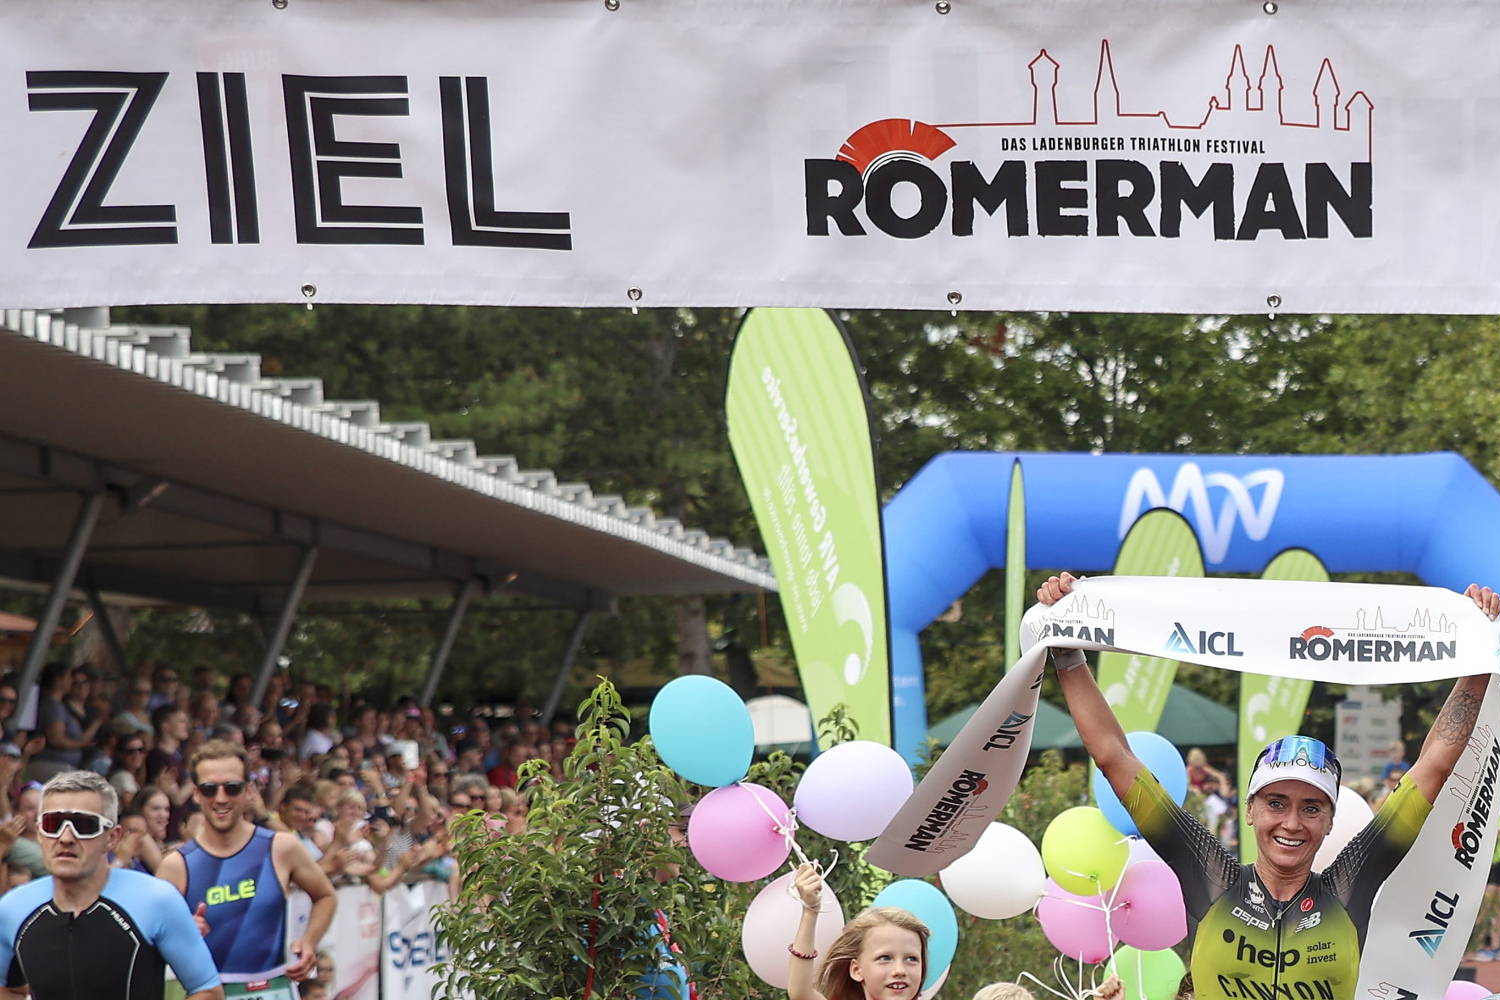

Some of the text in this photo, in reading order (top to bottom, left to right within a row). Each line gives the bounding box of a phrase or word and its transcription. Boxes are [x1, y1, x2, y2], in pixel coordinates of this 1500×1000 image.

[1001, 136, 1266, 155] DAS LADENBURGER TRIATHLON FESTIVAL
[26, 71, 573, 250] ZIEL
[1199, 630, 1244, 657] ICL
[983, 729, 1022, 752] ICL
[1424, 890, 1460, 929] ICL
[1236, 935, 1301, 973] hep
[1306, 953, 1337, 965] invest
[1217, 974, 1335, 1000] CANYON
